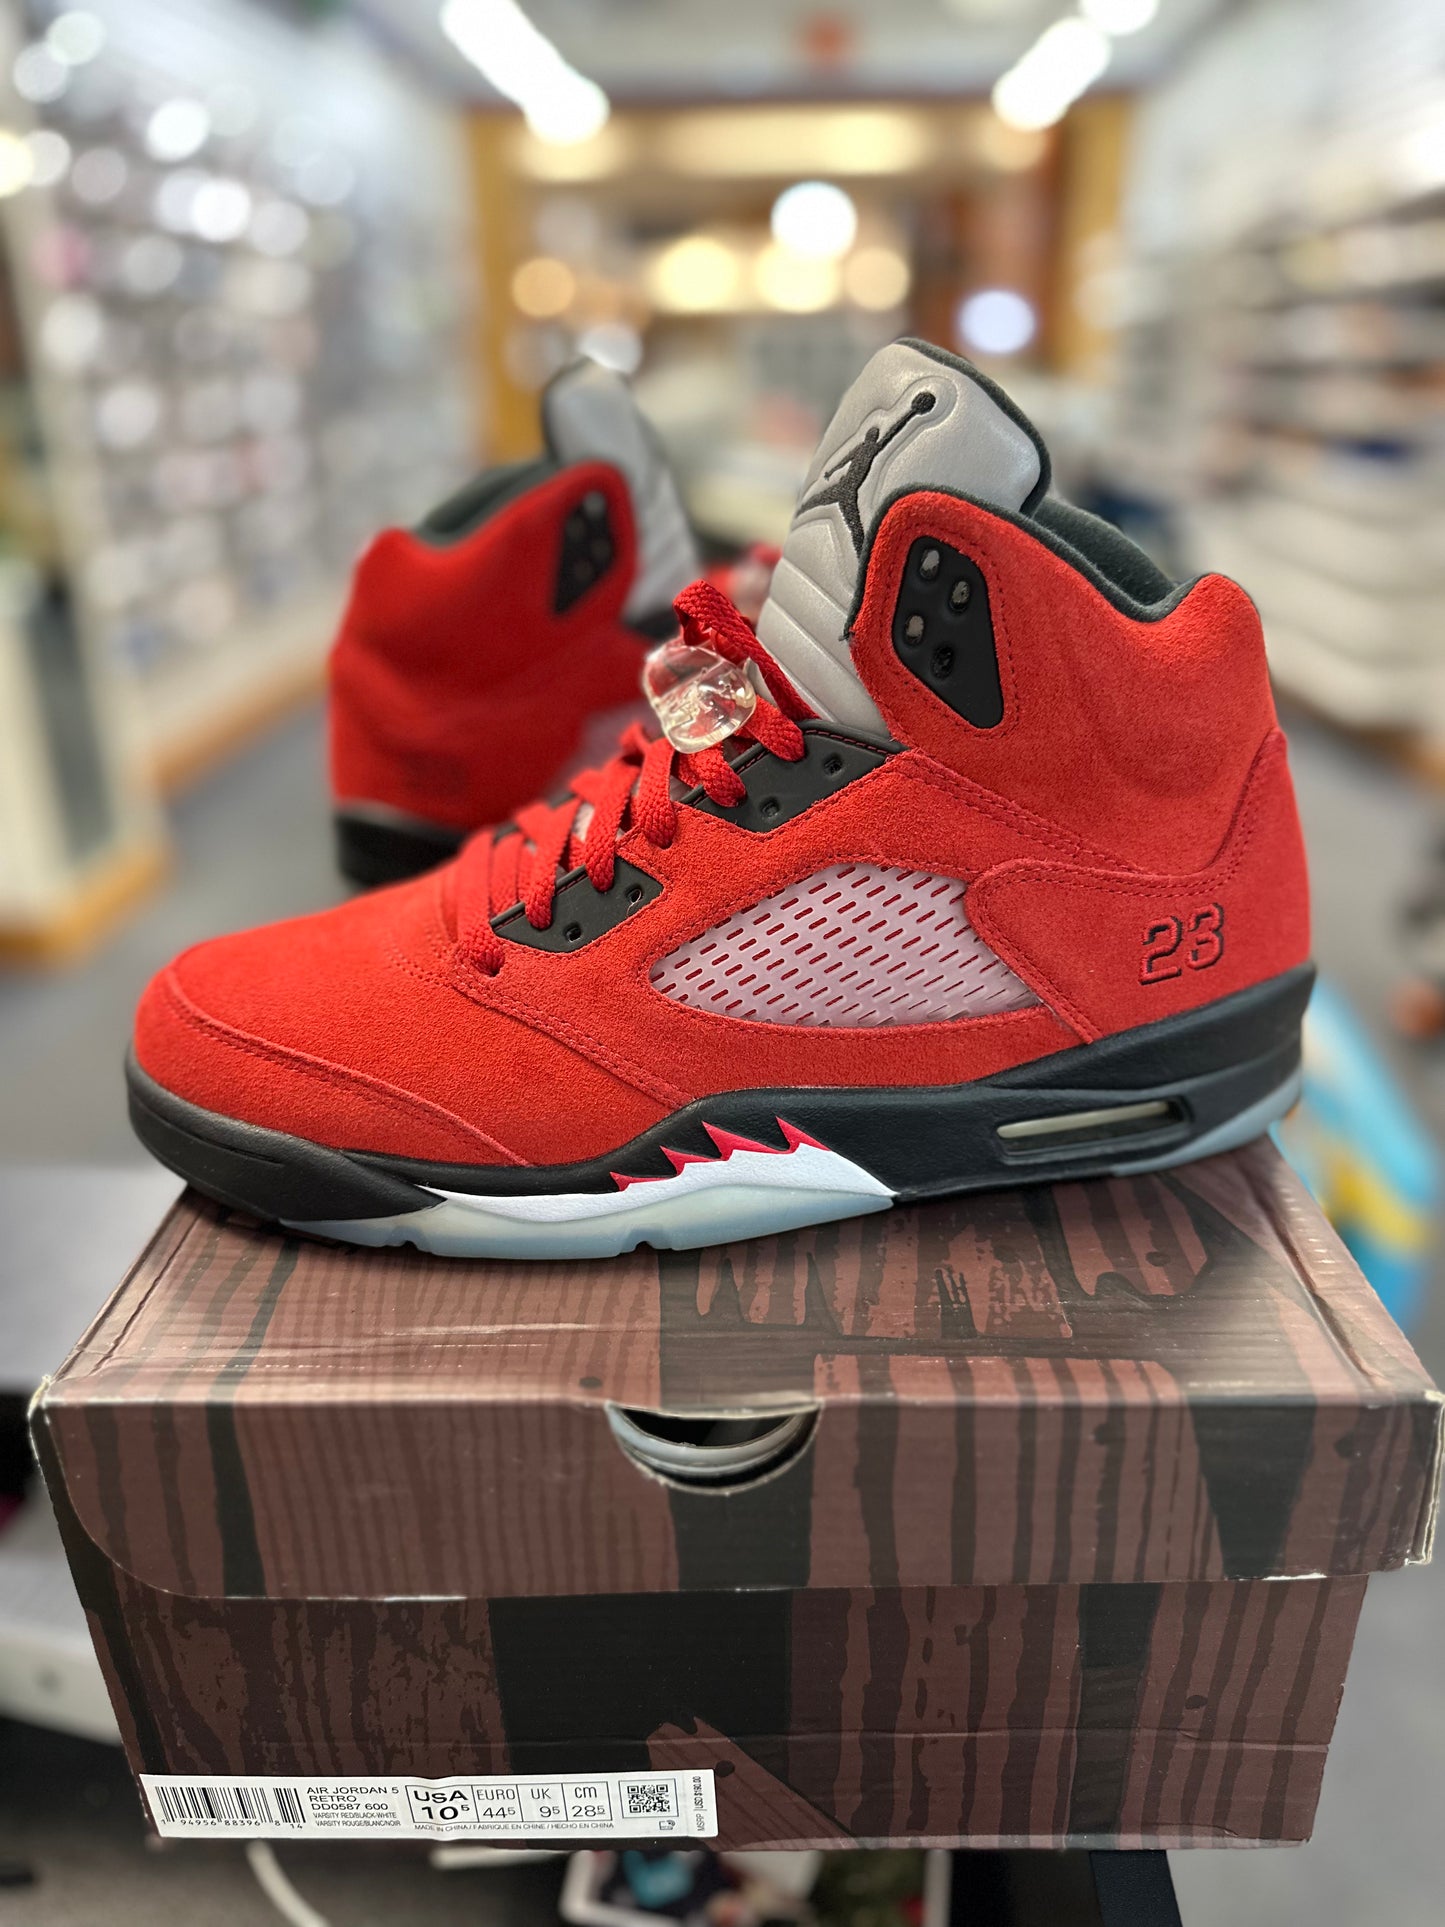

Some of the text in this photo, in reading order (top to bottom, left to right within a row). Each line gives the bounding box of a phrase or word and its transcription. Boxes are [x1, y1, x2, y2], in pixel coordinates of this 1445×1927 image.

[1138, 902, 1224, 986] 23
[306, 1786, 399, 1795] AIR JORDAN 5
[413, 1789, 469, 1804] USA
[477, 1788, 516, 1800] EURO
[530, 1788, 552, 1800] UK
[694, 1797, 703, 1809] USD
[695, 1813, 705, 1831] MSRP
